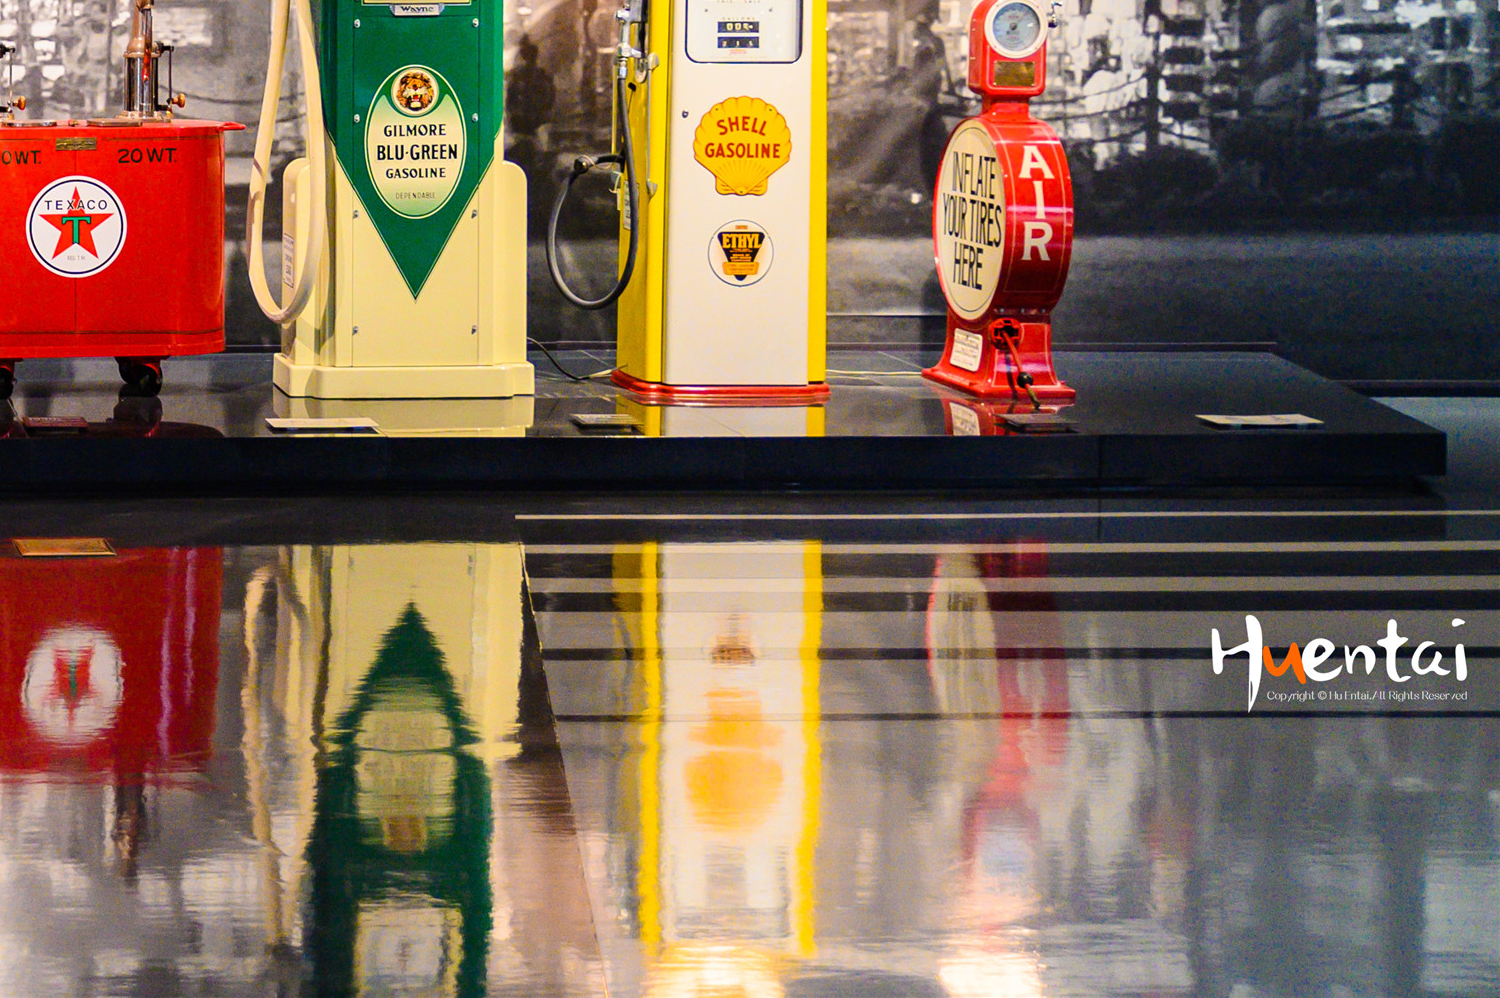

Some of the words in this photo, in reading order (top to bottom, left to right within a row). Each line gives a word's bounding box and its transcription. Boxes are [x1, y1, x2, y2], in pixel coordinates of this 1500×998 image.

[401, 5, 434, 14] Wayne
[383, 123, 447, 138] GILMORE
[716, 115, 767, 137] SHELL
[704, 142, 781, 159] GASOLINE
[385, 167, 447, 179] GASOLINE
[952, 151, 996, 200] INFLATE
[395, 191, 436, 200] DEPENDABLE
[1018, 145, 1055, 261] AIR
[44, 199, 108, 211] TEXACO
[942, 192, 968, 241] YOUR
[969, 198, 1002, 248] TIRES
[721, 233, 763, 249] ETHYL
[952, 241, 984, 291] HERE
